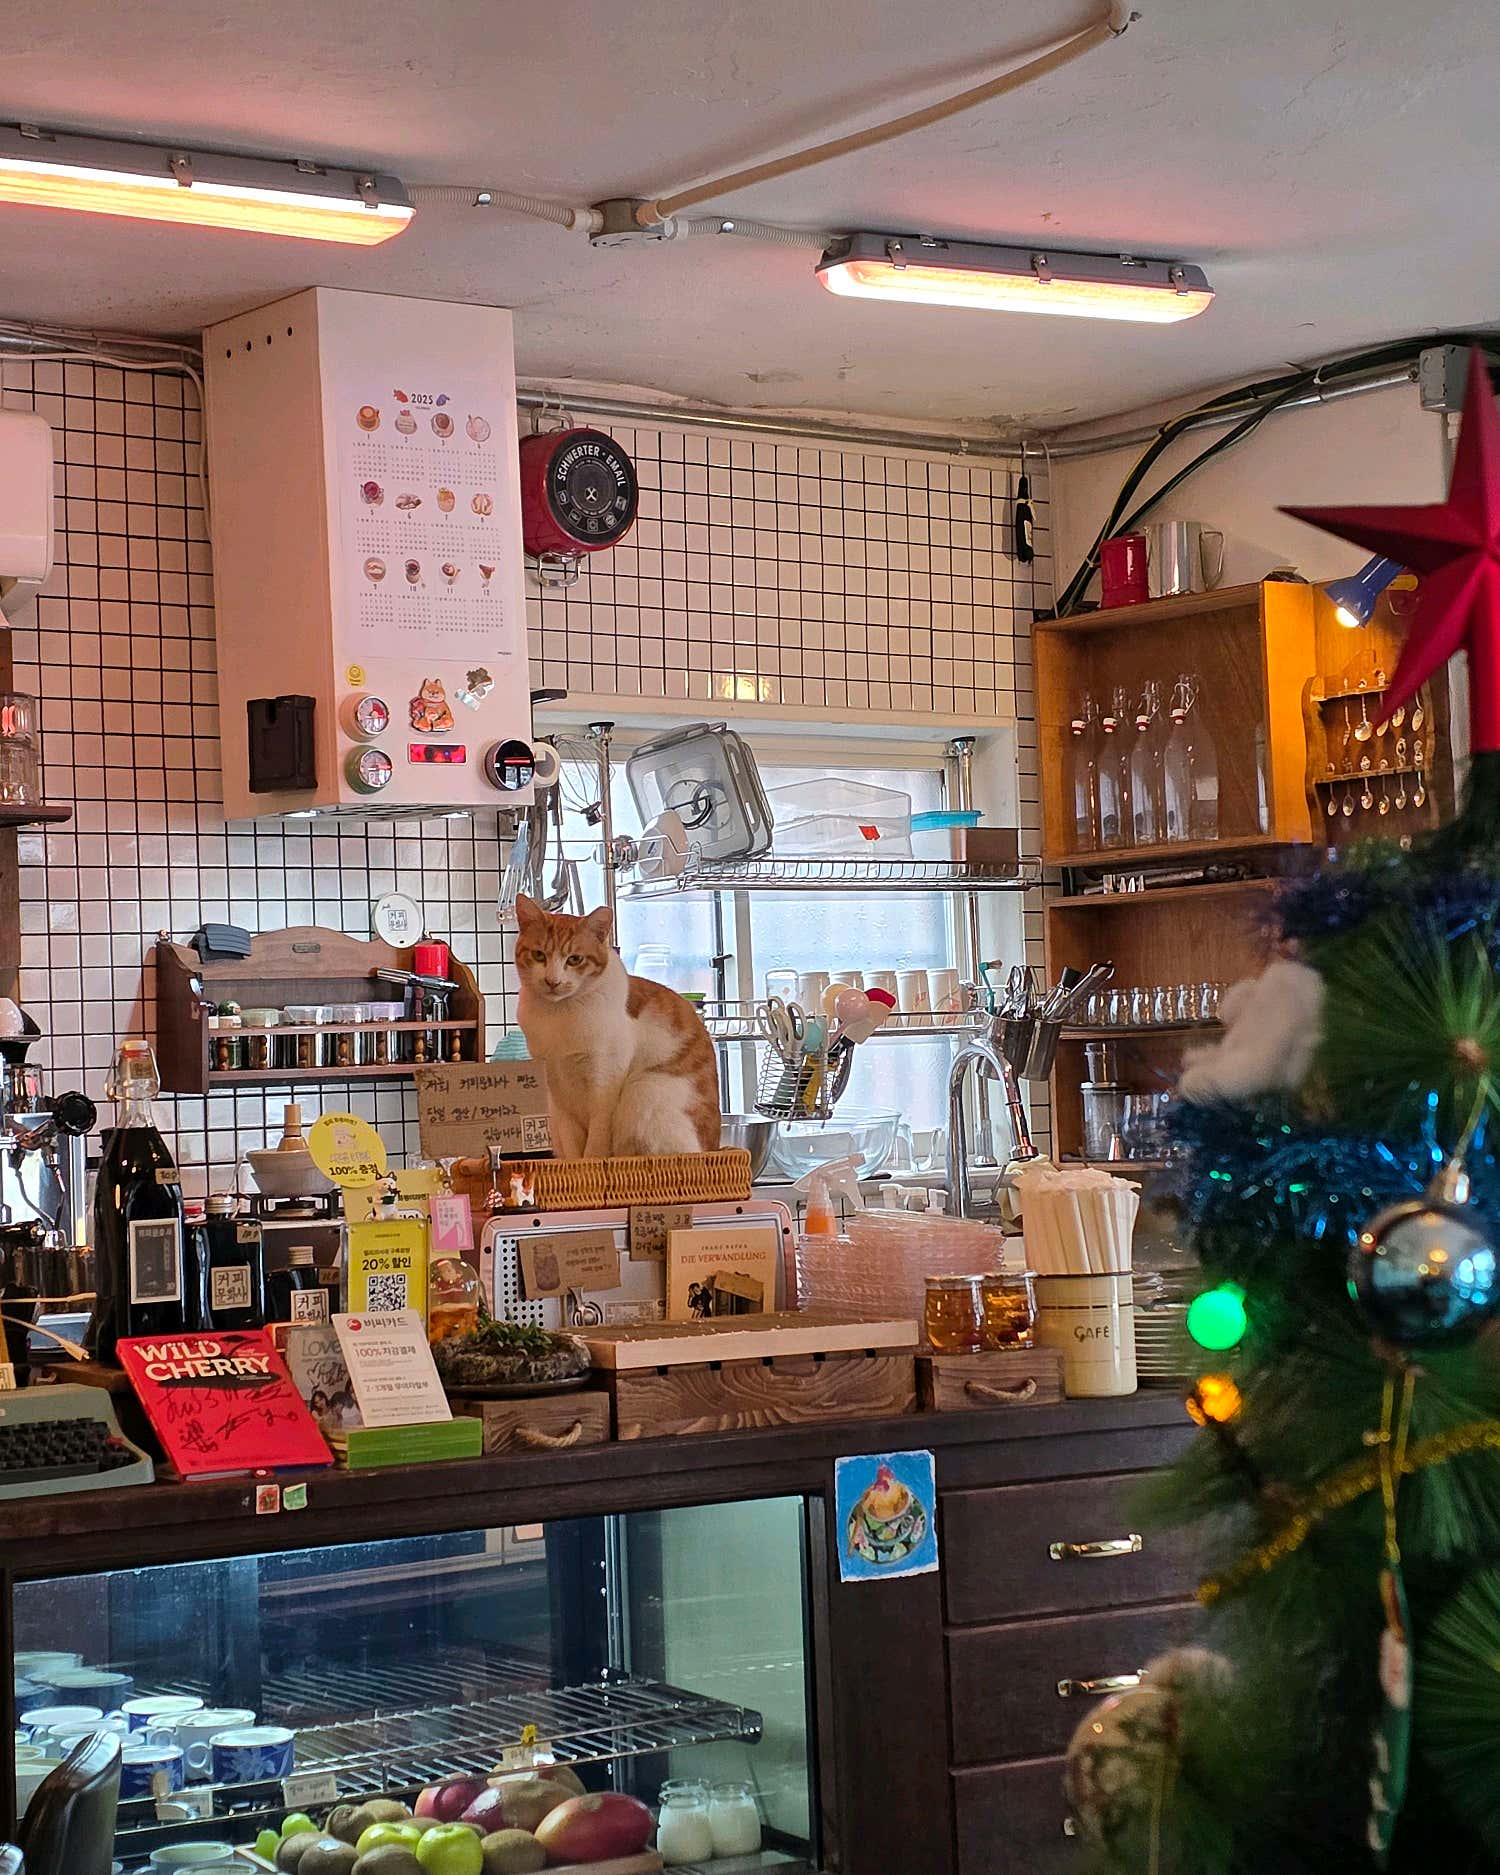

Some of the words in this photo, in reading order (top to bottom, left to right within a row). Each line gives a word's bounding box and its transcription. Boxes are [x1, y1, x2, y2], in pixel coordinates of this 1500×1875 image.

[411, 393, 434, 405] 2025
[557, 445, 600, 481] SCHWERTER
[605, 455, 626, 487] EMAIL
[329, 1166, 358, 1176] 100%
[362, 1258, 390, 1271] 20%
[392, 1256, 412, 1269] 할인
[681, 1255, 697, 1264] DIE
[698, 1251, 767, 1263] VERWANDLUNG
[133, 1340, 221, 1362] WILD
[144, 1356, 270, 1381] CHERRY
